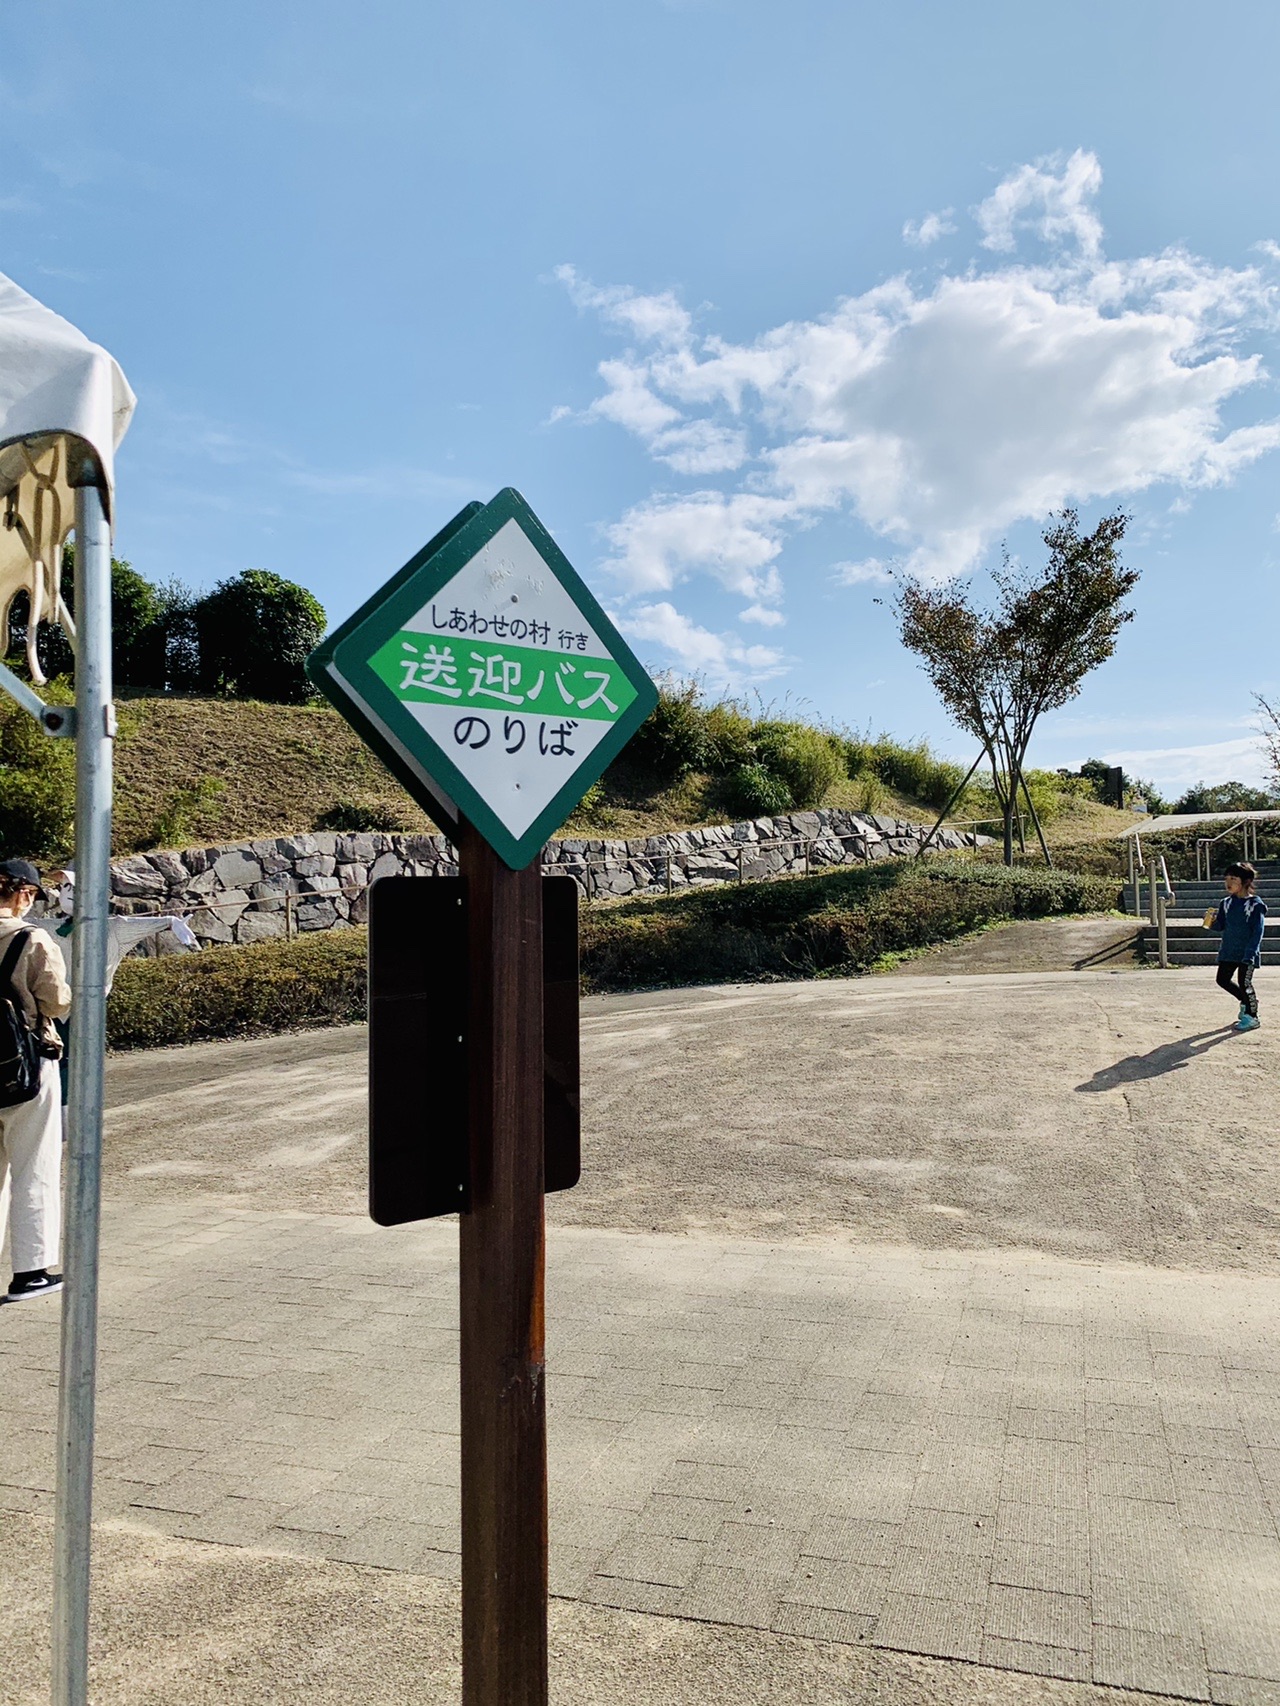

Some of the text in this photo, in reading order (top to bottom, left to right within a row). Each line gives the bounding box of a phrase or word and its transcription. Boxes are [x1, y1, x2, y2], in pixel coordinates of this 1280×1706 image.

[432, 604, 589, 651] しあわせの村 行き
[399, 642, 619, 714] 送迎バス
[454, 716, 579, 756] のりば
